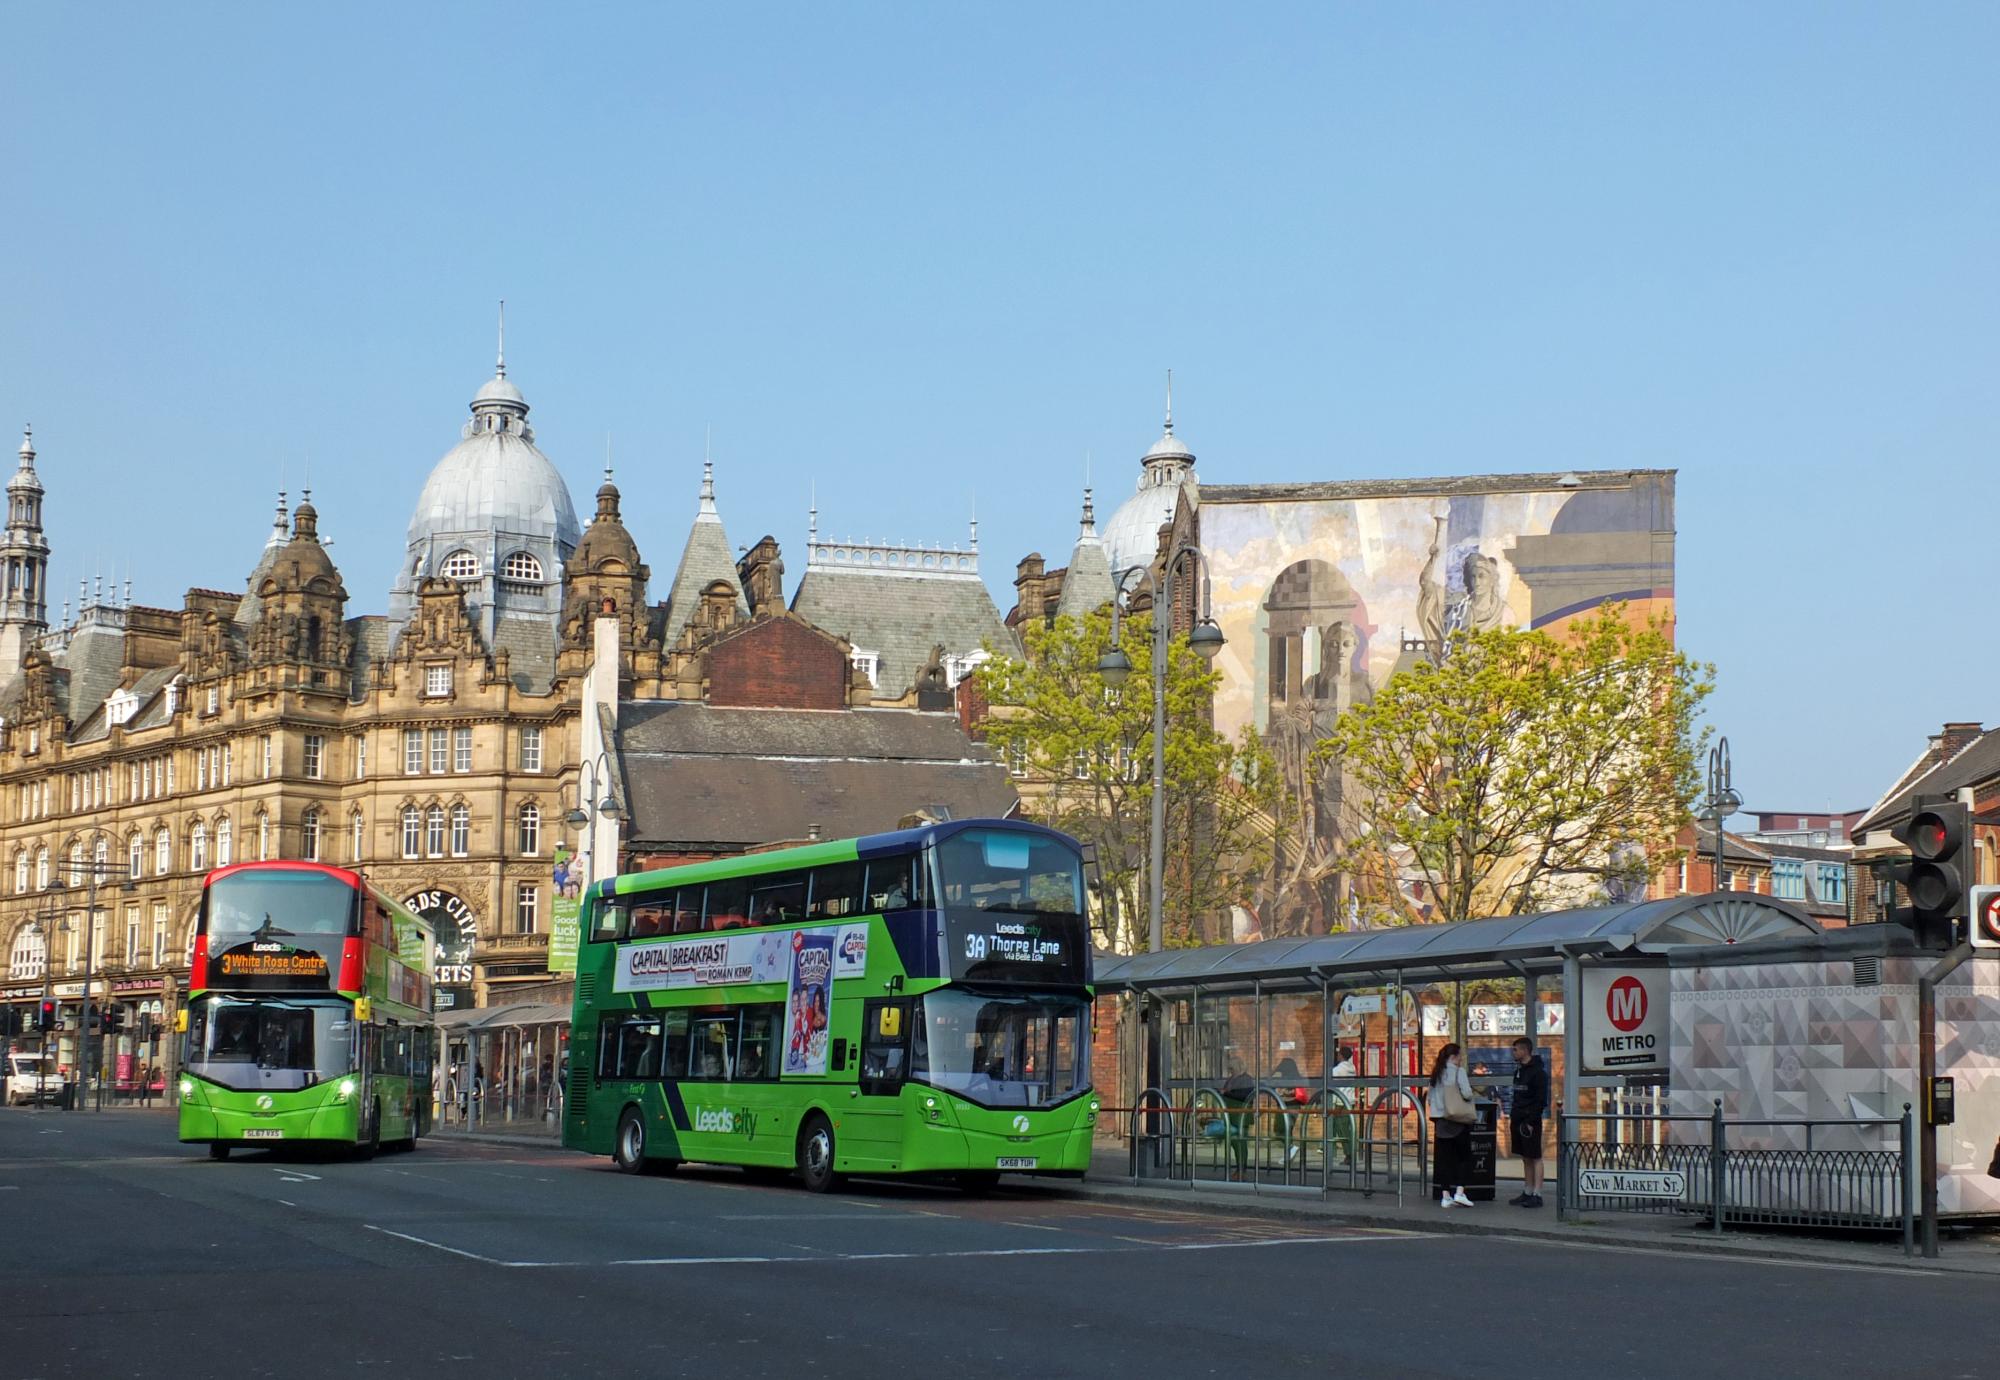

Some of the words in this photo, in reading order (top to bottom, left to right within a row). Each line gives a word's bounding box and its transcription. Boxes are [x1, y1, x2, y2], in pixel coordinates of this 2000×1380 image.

[405, 891, 441, 914] EDS
[446, 896, 478, 935] CITY
[554, 915, 577, 925] Good
[554, 925, 577, 937] luck
[846, 941, 867, 952] CAPITAL
[966, 934, 985, 958] 3A
[990, 935, 1029, 953] Thorpe
[1033, 938, 1060, 955] Lane
[222, 953, 232, 974] 3
[232, 955, 260, 967] White
[263, 955, 288, 968] Rose
[292, 956, 325, 969] Centre
[632, 948, 668, 968] CAPITAL
[672, 944, 726, 965] BREAKFAST
[800, 950, 829, 967] CAPITAL
[1016, 953, 1031, 961] Belle
[435, 965, 472, 982] KETS
[708, 967, 734, 980] ROMAN
[735, 966, 752, 978] KEMP
[1612, 987, 1642, 1021] M
[1442, 1008, 1486, 1020] J'S
[1437, 1020, 1490, 1031] PCE
[1602, 1034, 1656, 1051] METRO
[1000, 1159, 1019, 1167] SK68
[1020, 1159, 1034, 1167] TUH
[1586, 1175, 1610, 1190] NEW
[1613, 1175, 1659, 1192] MARKET
